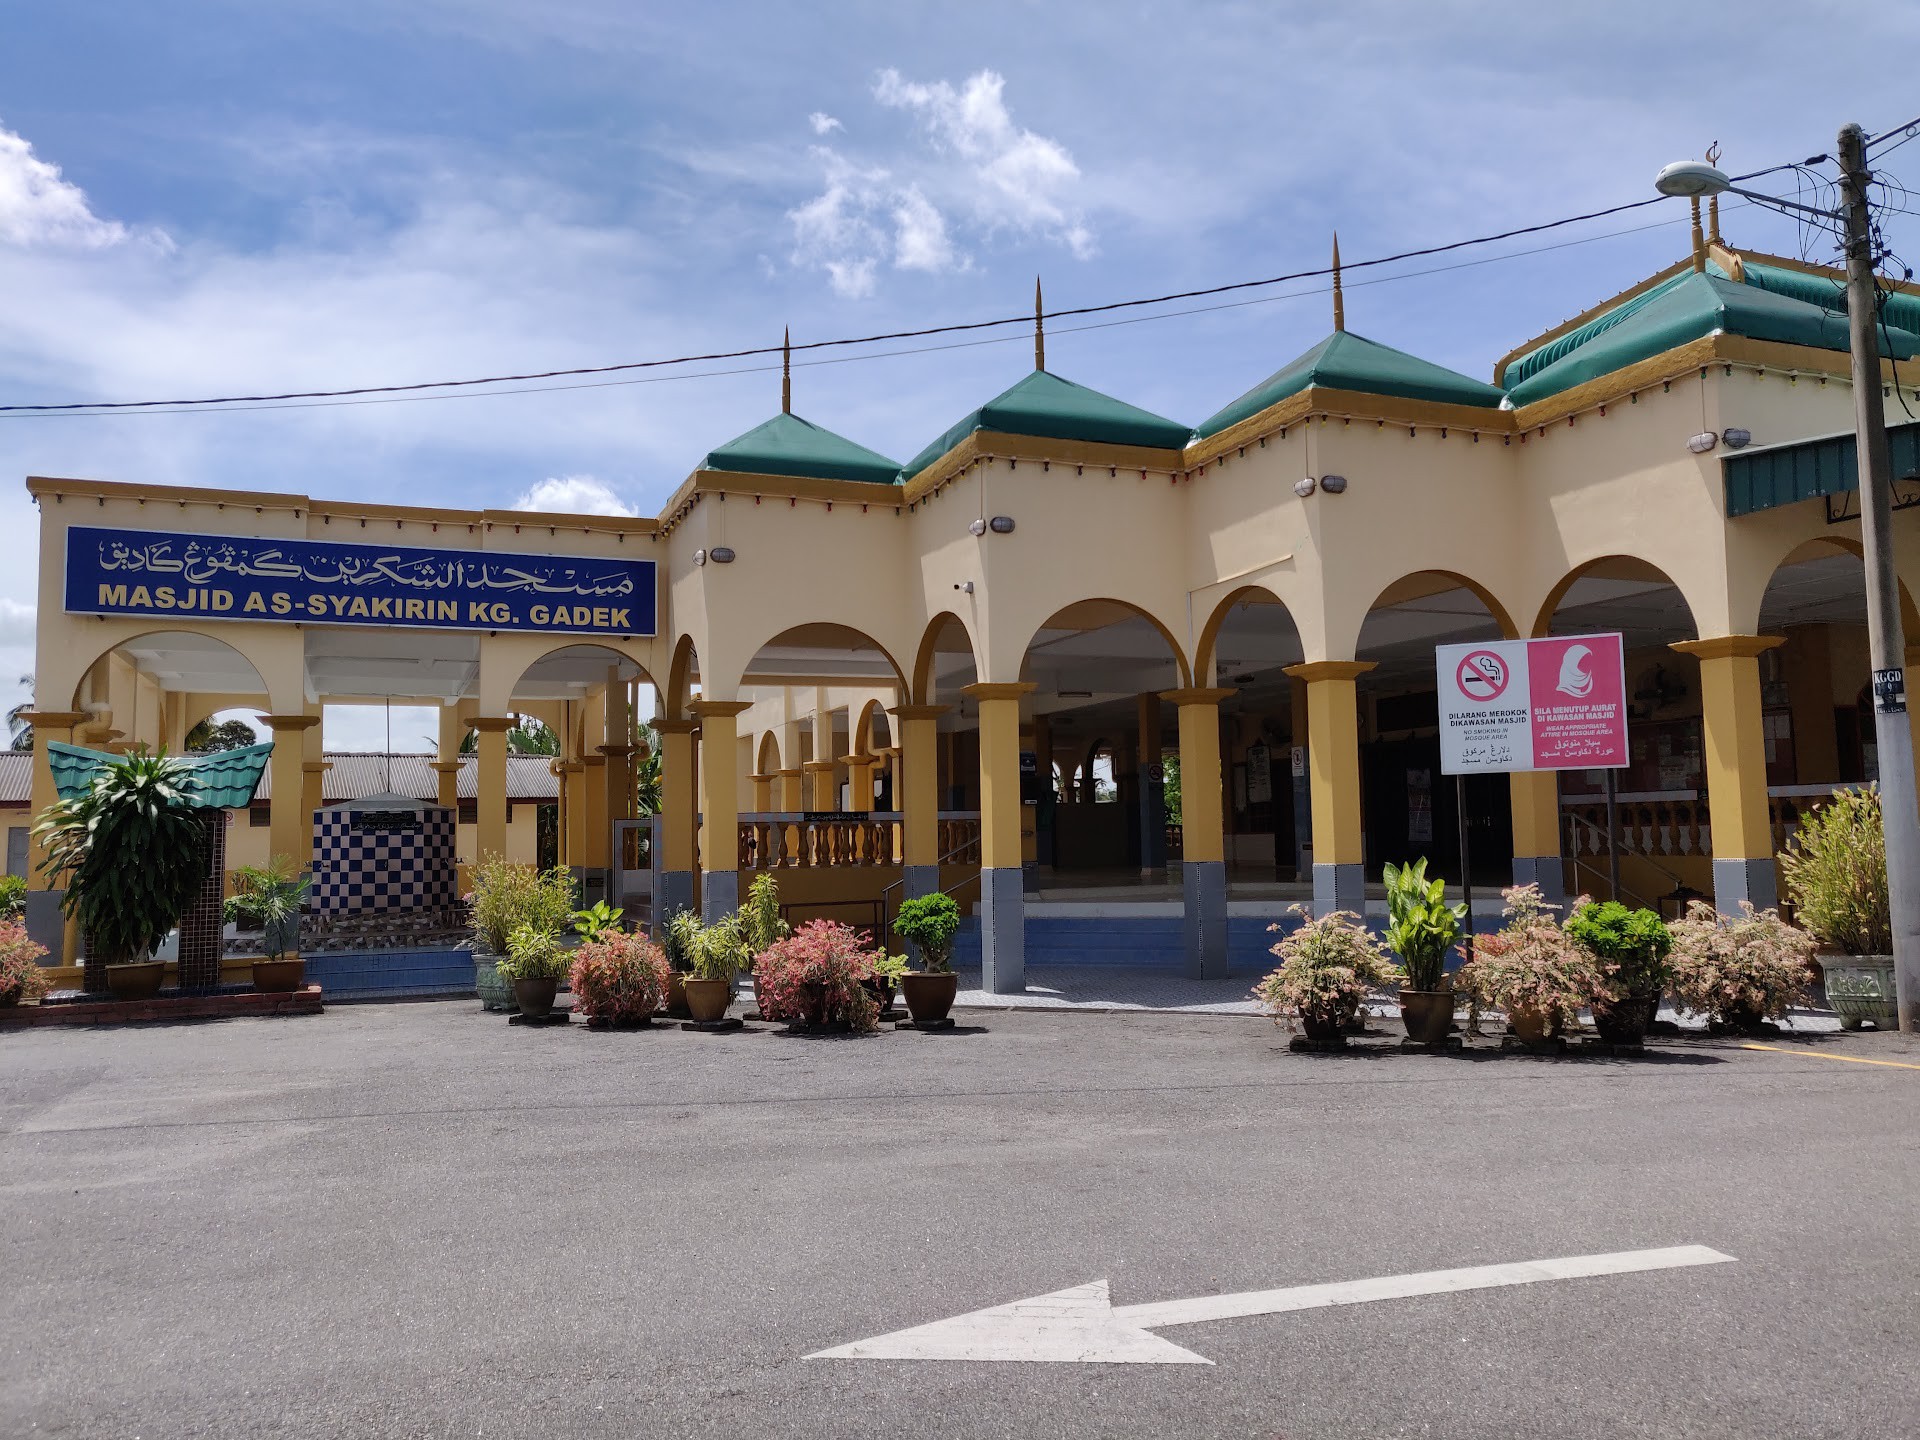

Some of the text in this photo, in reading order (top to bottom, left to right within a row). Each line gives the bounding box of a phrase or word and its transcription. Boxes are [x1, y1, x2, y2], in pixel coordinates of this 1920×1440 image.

[98, 584, 632, 628] MASJID AS-SYAKIRIN KG. GADEK
[1873, 671, 1901, 683] KGGD
[1448, 709, 1527, 719] DILARANG MEROKOK
[1552, 705, 1589, 713] MENUTUP
[1547, 713, 1584, 722] KAWASAN
[1586, 711, 1614, 719] MASJID
[1450, 719, 1496, 727] DIKAWASAN
